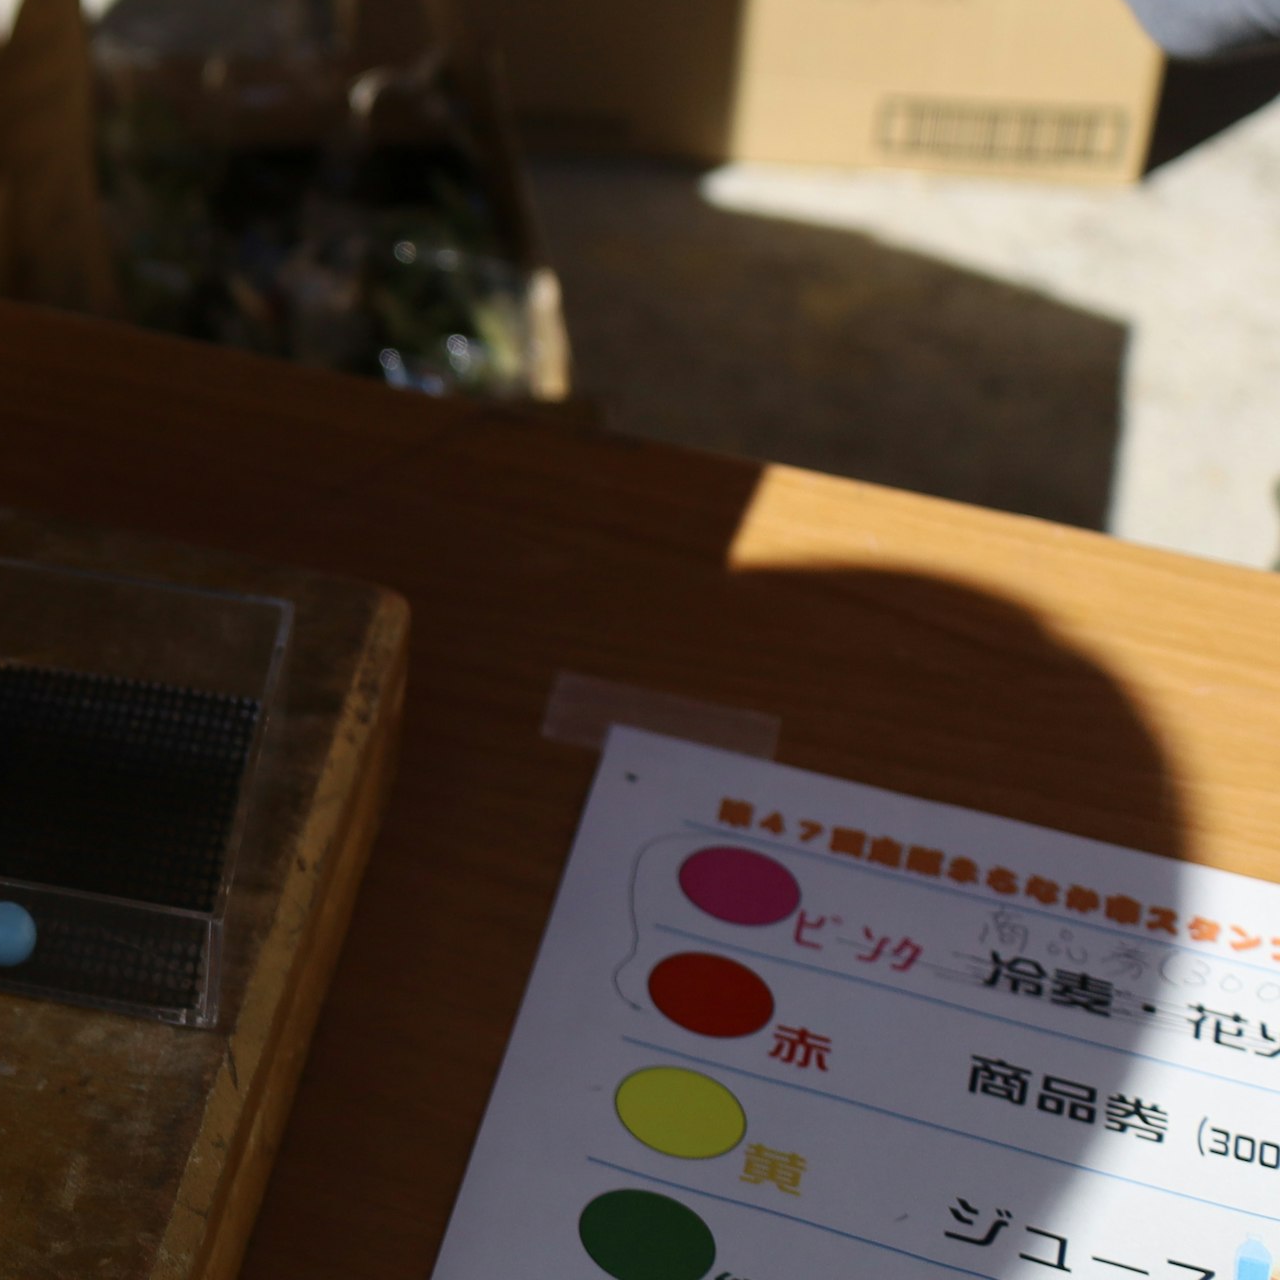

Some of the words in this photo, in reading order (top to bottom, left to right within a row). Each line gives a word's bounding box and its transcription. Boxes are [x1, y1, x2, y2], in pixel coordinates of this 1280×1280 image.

[767, 1023, 833, 1072] 赤
[968, 1054, 1169, 1144] 商品券
[739, 1143, 808, 1197] 黄
